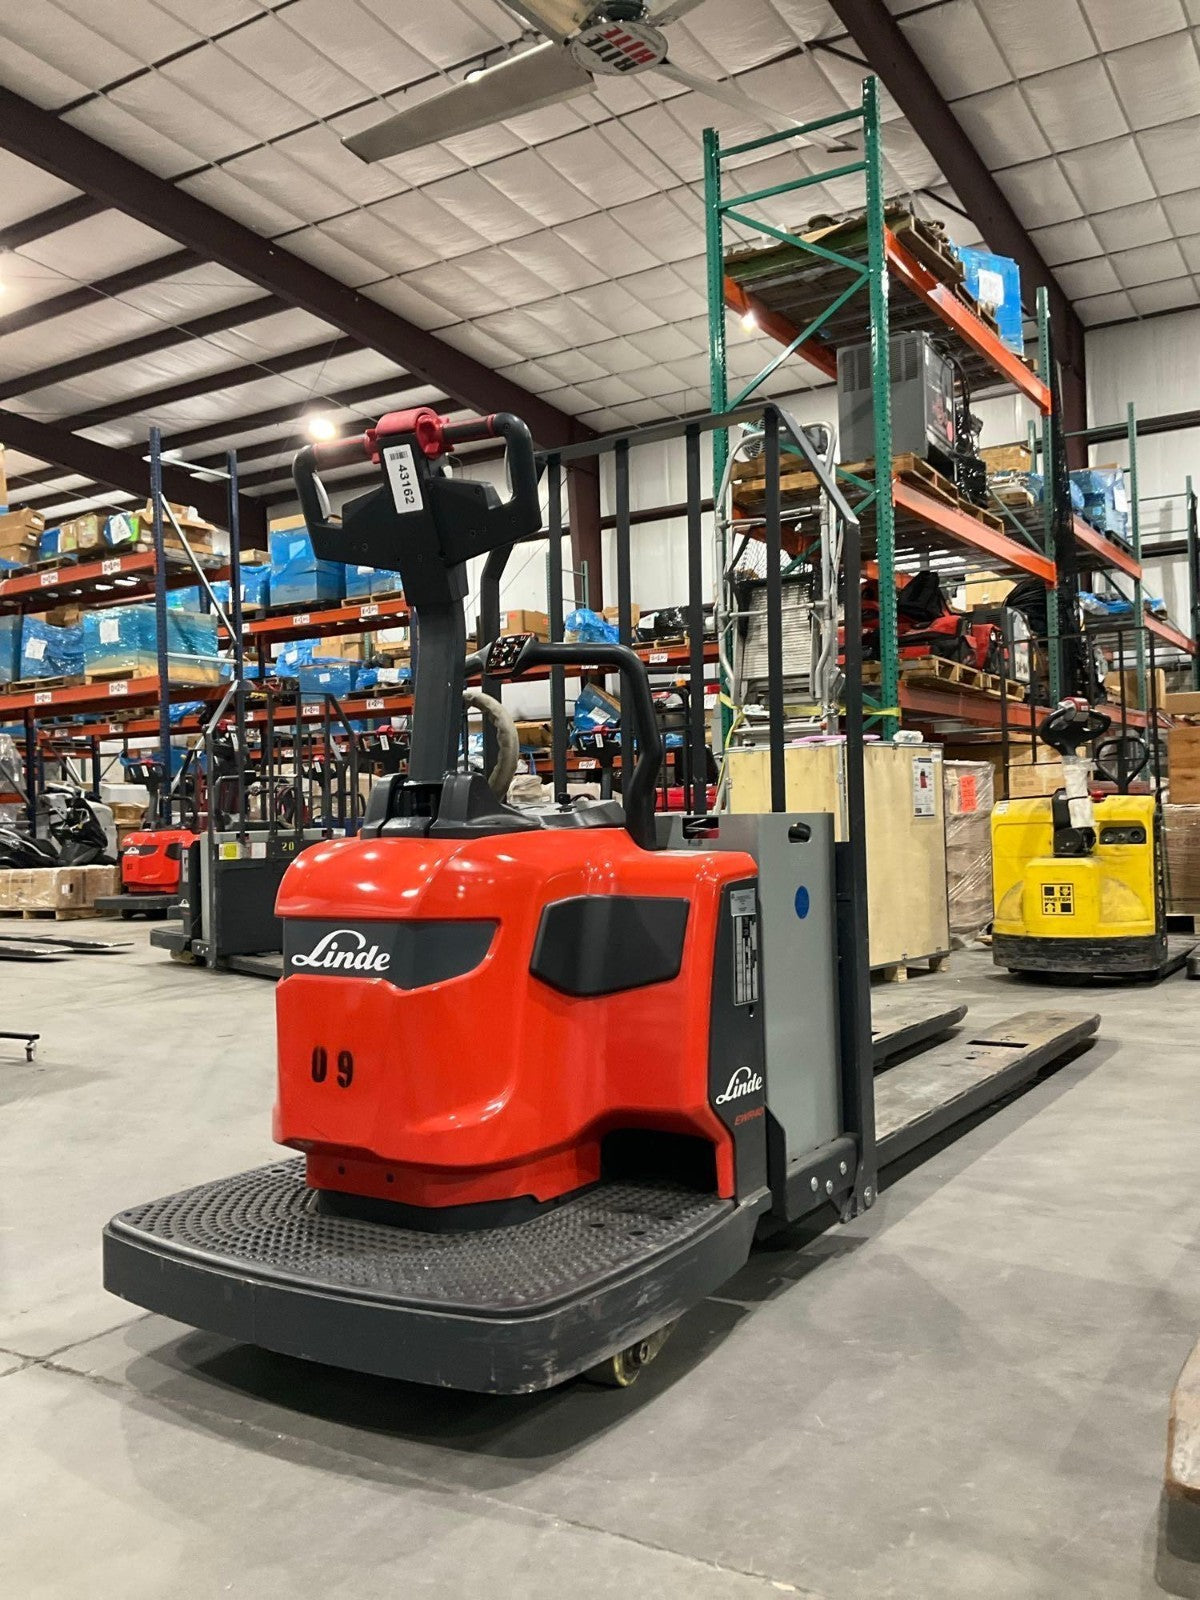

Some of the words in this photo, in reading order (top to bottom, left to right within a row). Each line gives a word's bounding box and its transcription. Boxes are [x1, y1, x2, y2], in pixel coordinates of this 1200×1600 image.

[580, 33, 639, 72] RITE
[603, 24, 658, 65] HITE
[398, 464, 415, 505] 43162
[281, 841, 295, 851] 20
[291, 929, 391, 971] Linde
[715, 1066, 763, 1105] Linde
